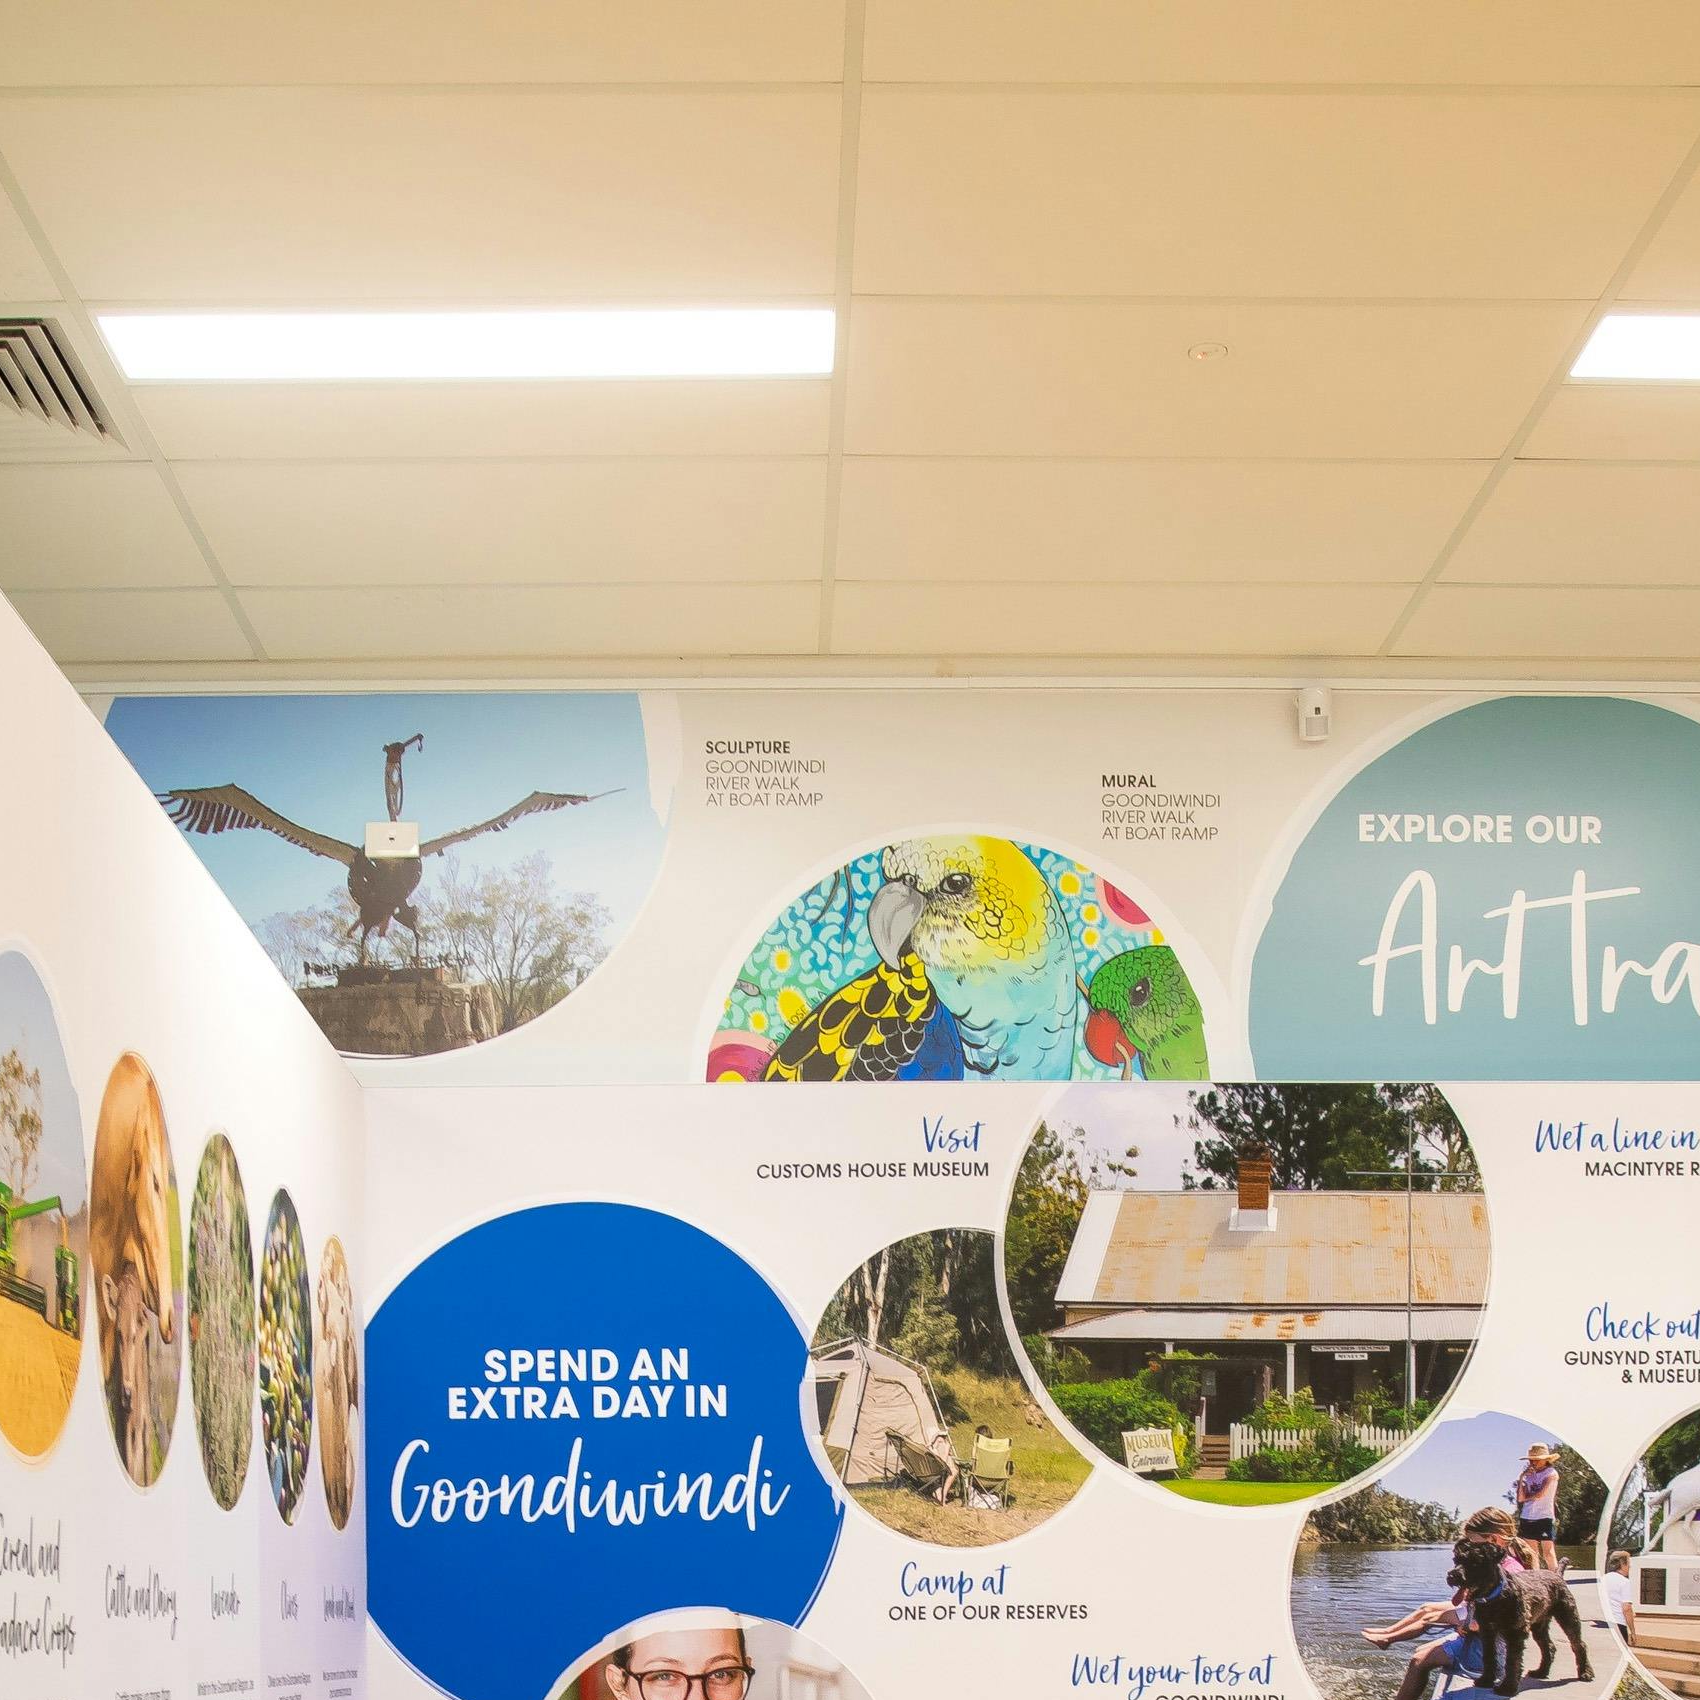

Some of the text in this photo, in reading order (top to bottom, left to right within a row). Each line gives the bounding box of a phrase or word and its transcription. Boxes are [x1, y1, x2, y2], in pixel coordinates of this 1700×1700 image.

[706, 741, 790, 754] SCULPTURE
[706, 760, 825, 773] GOONDIWINDI
[706, 776, 799, 790] RIVER WALK
[1103, 775, 1156, 787] MURAL
[707, 793, 823, 806] AT BOAT RAMP
[1102, 794, 1220, 807] GOONDIWINDI
[1103, 810, 1194, 823] RIVER WALK
[1102, 827, 1218, 840] AT BOAT RAMP
[1359, 814, 1601, 843] EXPLORE OUR
[924, 1116, 986, 1153] Visit
[1536, 1120, 1586, 1152] Wet
[1591, 1134, 1607, 1151] a
[1614, 1118, 1662, 1152] line
[1671, 1131, 1699, 1150] in
[757, 1162, 988, 1179] CUSTOMS HOUSE MUSEUM
[1586, 1162, 1684, 1176] MACINTYRE
[1587, 1302, 1660, 1342] Check
[485, 1348, 688, 1382] SPEND AN
[1565, 1351, 1649, 1365] GUNSYND
[1622, 1369, 1632, 1383] &
[449, 1385, 726, 1419] EXTRA DAY IN
[391, 1435, 790, 1533] Goondiwindi
[901, 1562, 1006, 1604] Camp at
[889, 1605, 1087, 1620] ONE OF OUR RESERVES
[1072, 1654, 1122, 1686] Wet
[1192, 1655, 1244, 1686] toes
[1249, 1654, 1275, 1684] at
